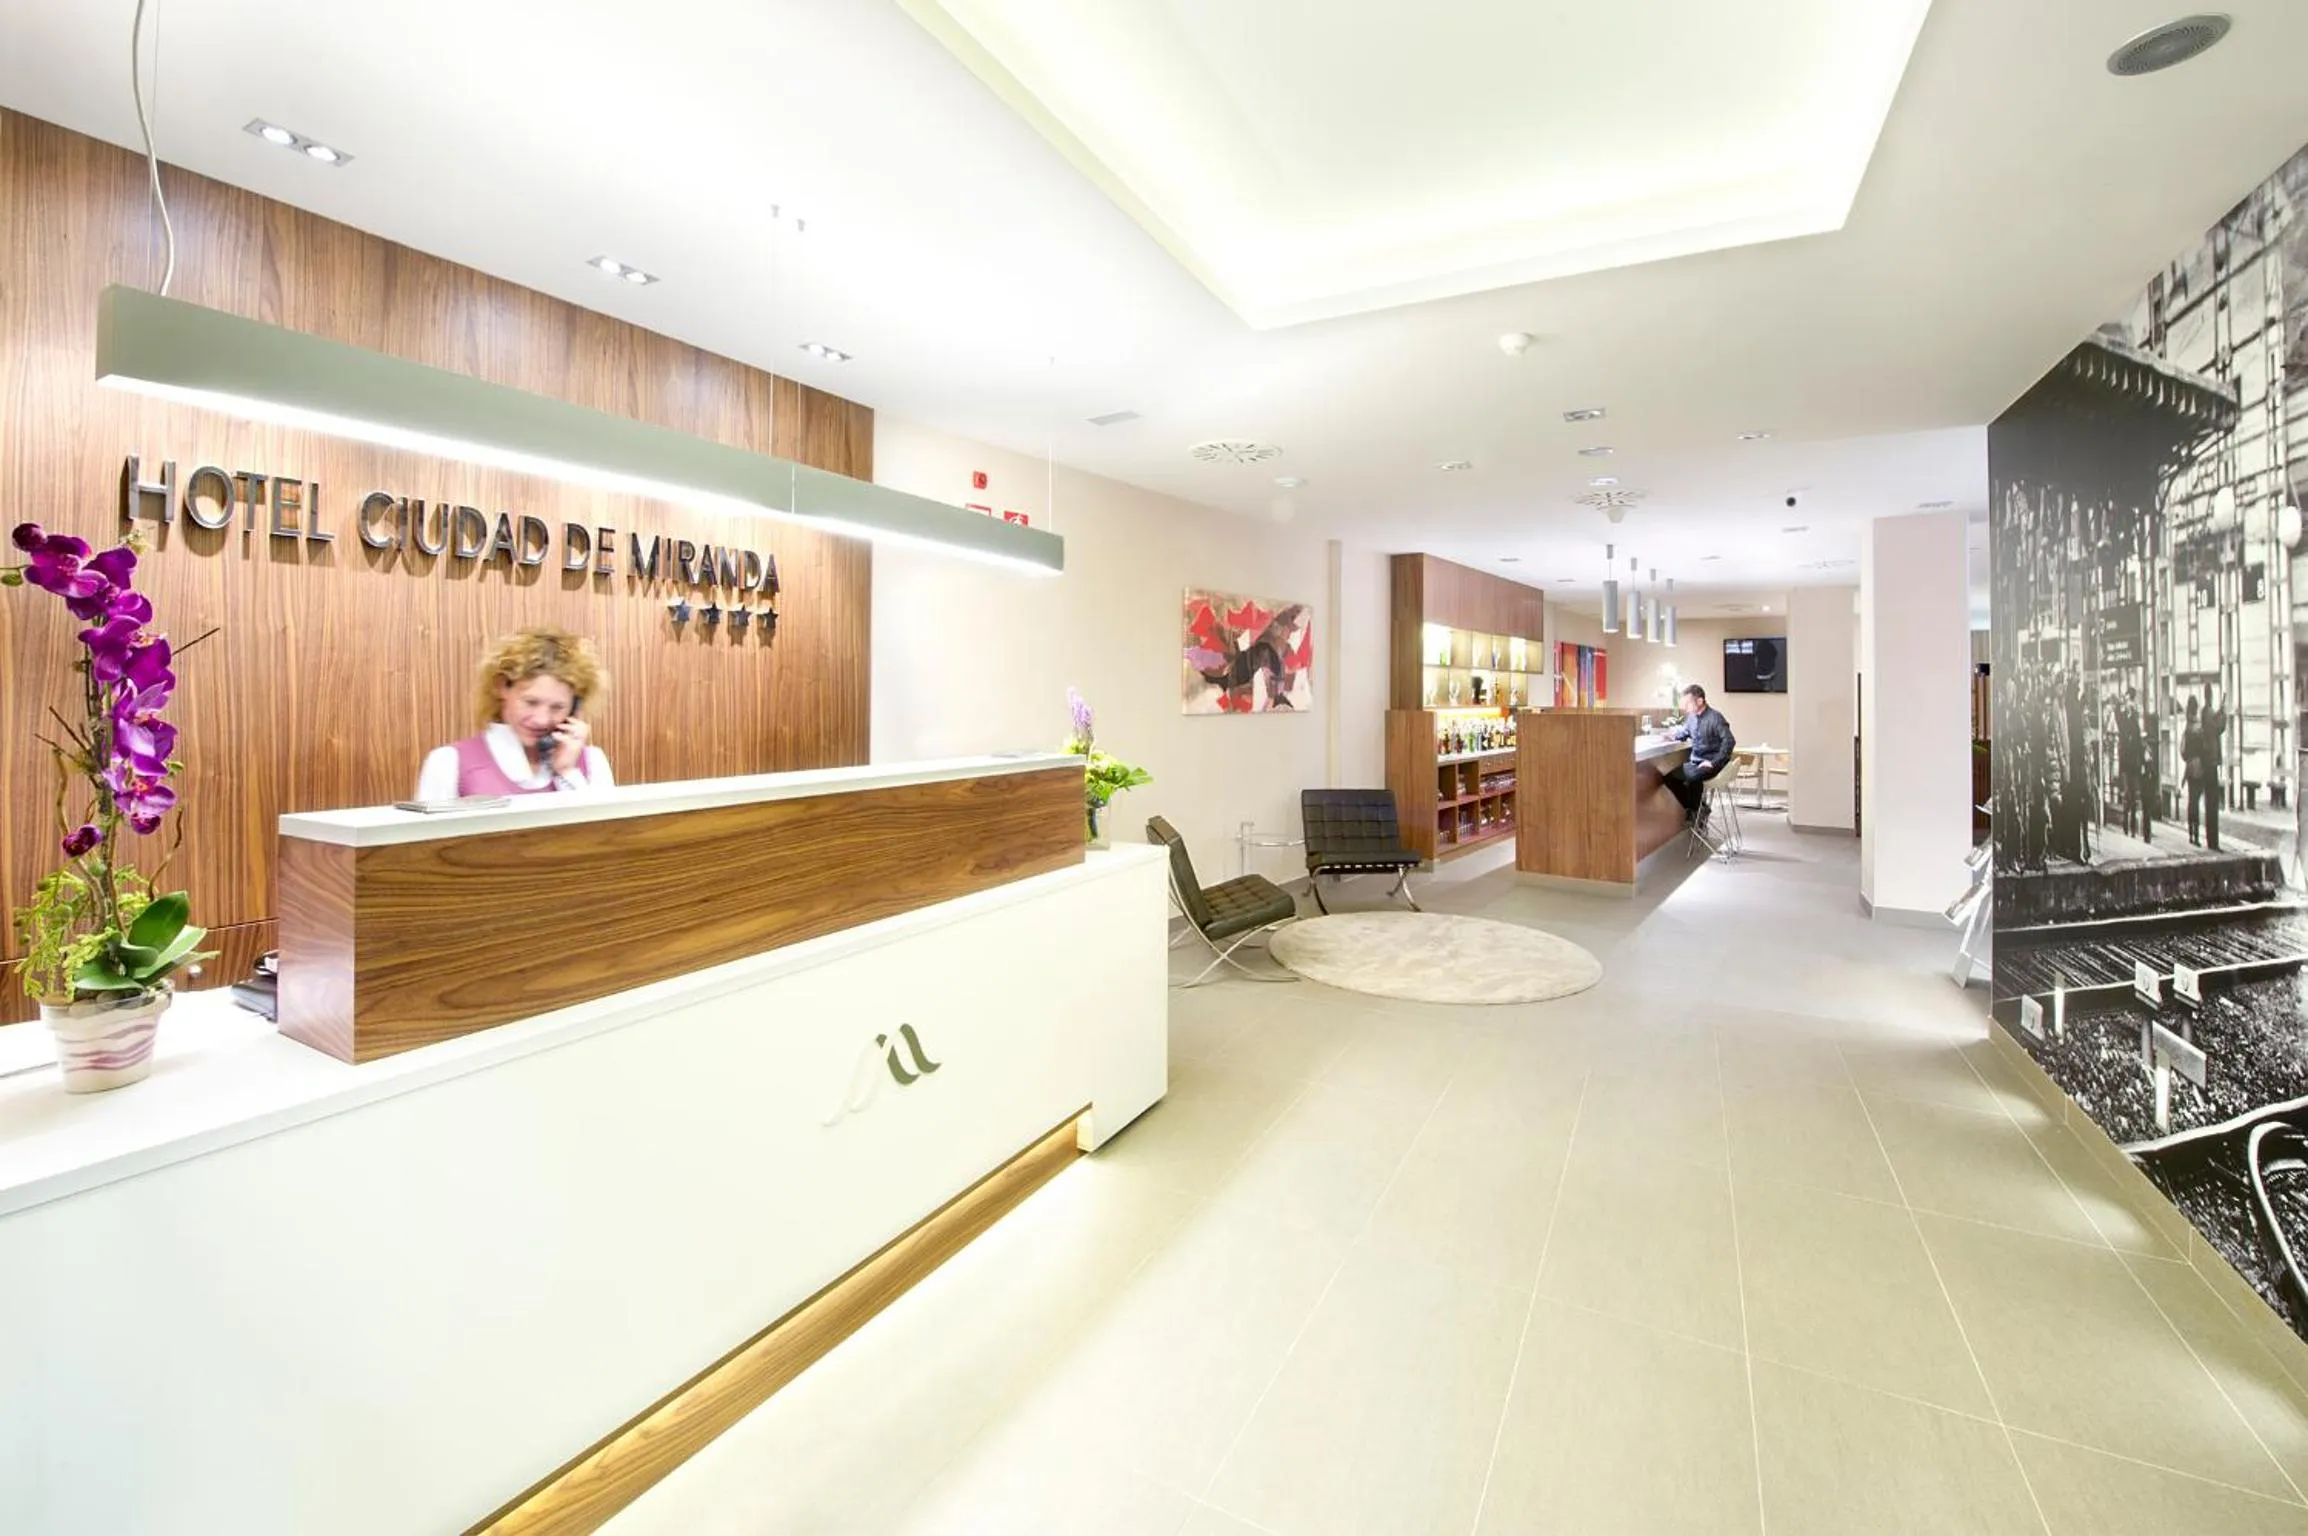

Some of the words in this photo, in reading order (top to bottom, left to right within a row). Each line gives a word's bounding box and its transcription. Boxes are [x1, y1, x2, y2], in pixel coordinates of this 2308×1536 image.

[125, 454, 335, 542] HOTEL
[359, 491, 550, 566] CIUDAD
[562, 522, 616, 575] DE
[628, 532, 781, 594] MIRANDA
